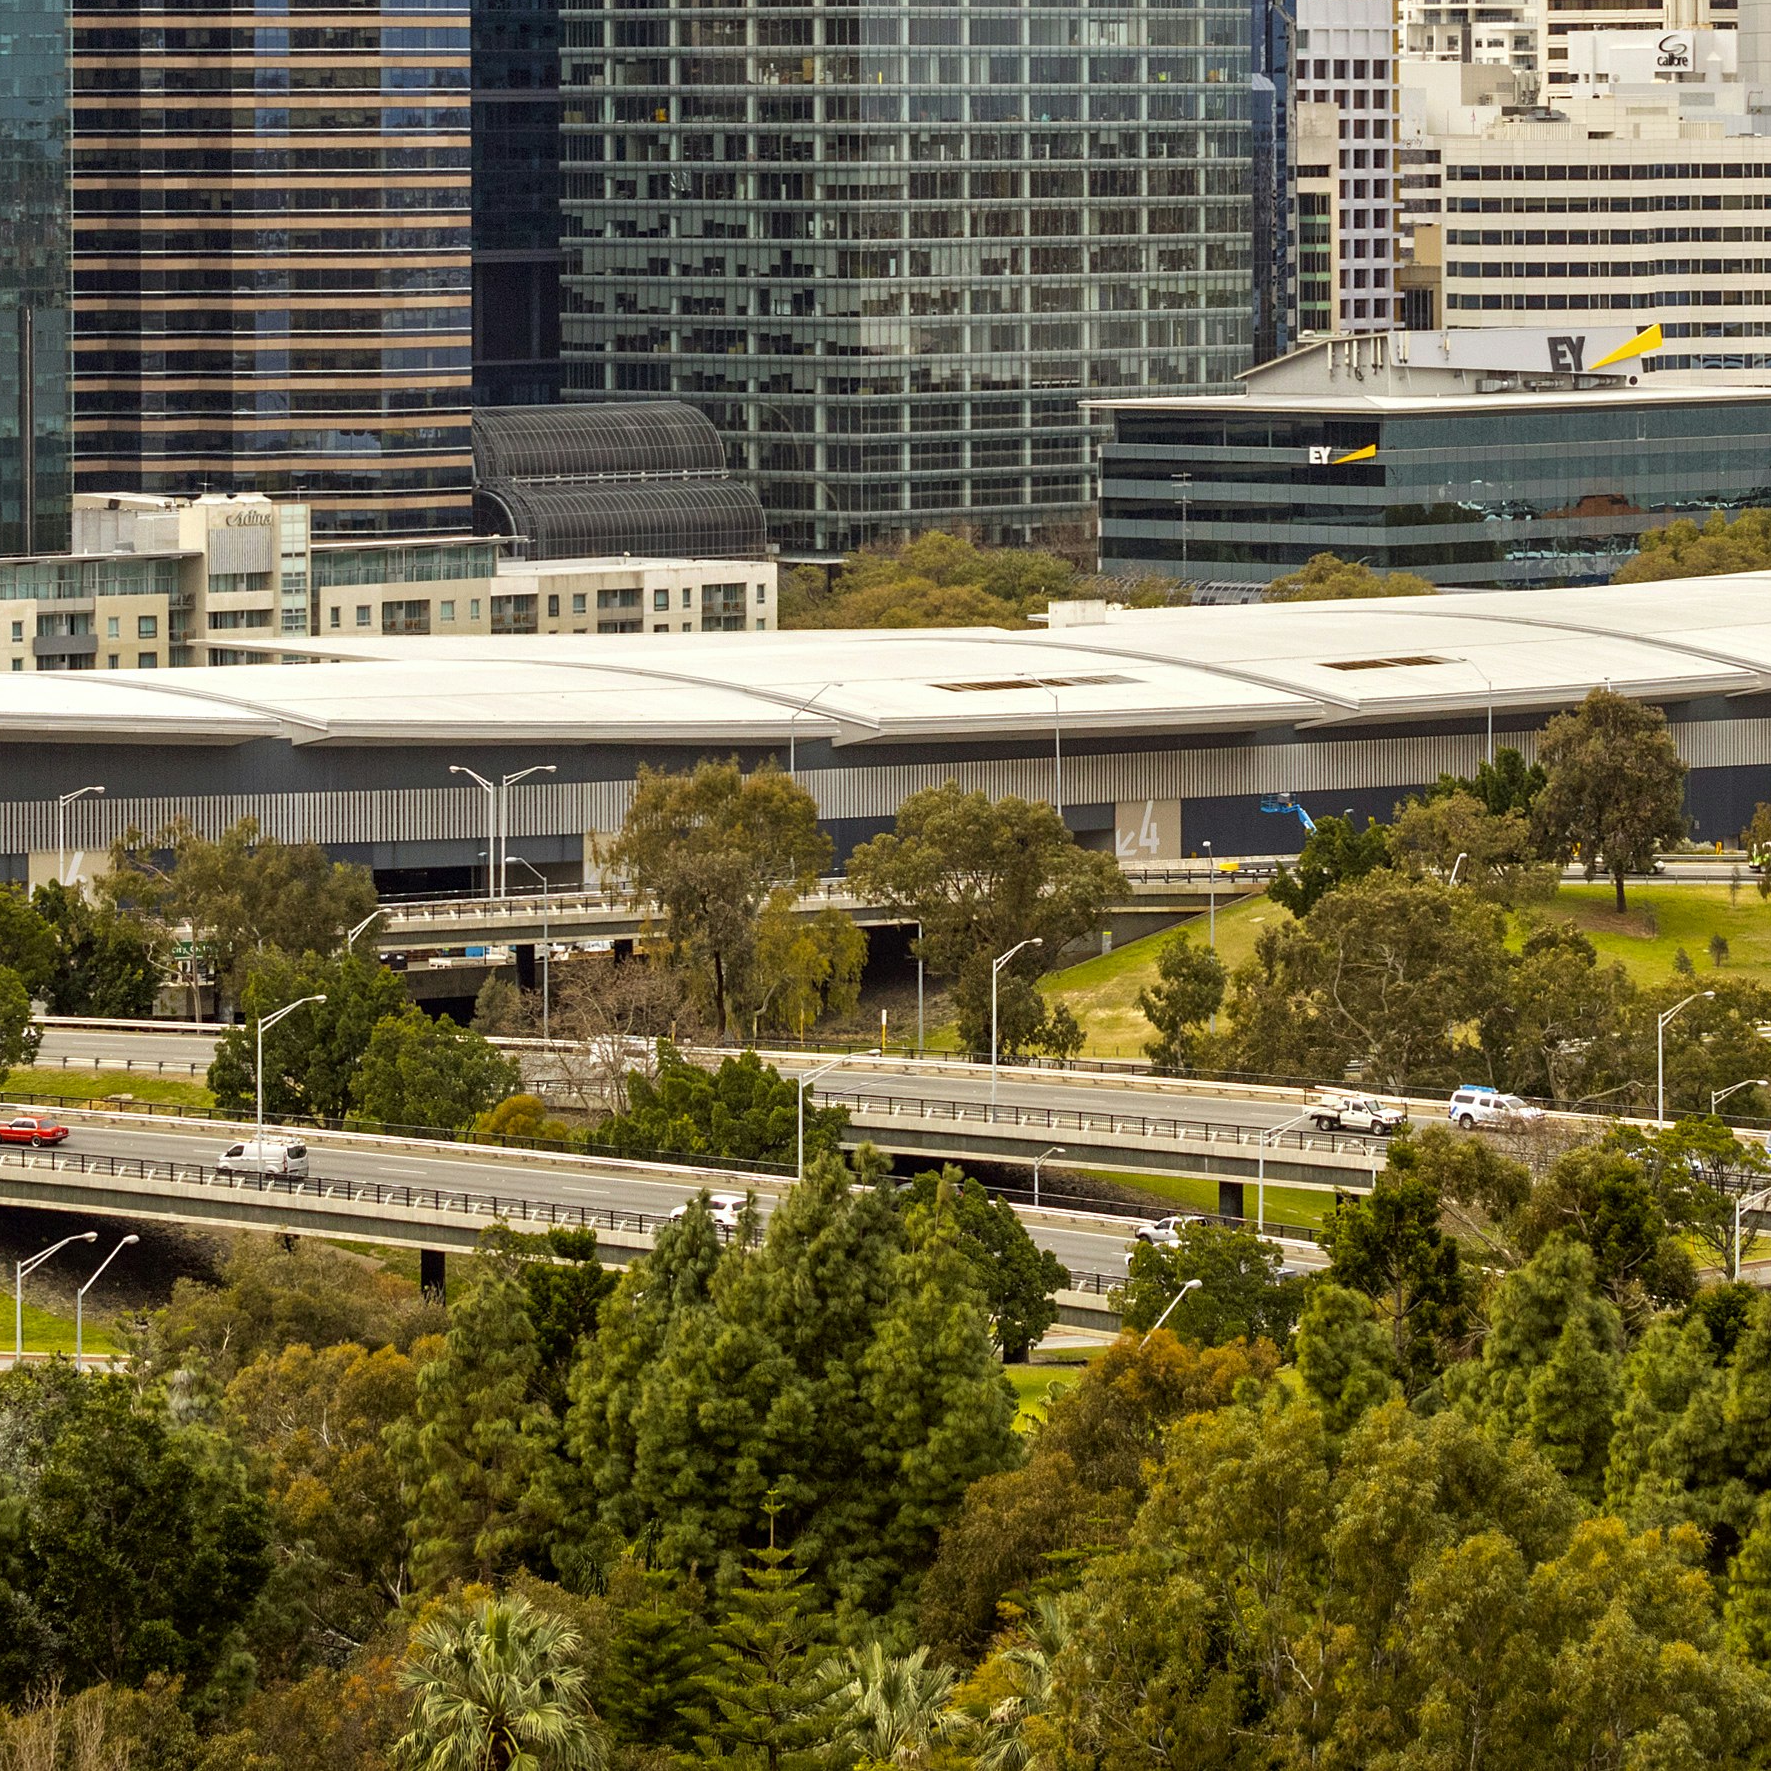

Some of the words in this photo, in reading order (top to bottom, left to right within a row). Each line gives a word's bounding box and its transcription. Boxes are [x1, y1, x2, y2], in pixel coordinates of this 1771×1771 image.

[1546, 335, 1586, 372] EY
[1308, 446, 1332, 464] EY
[1139, 800, 1160, 854] 4
